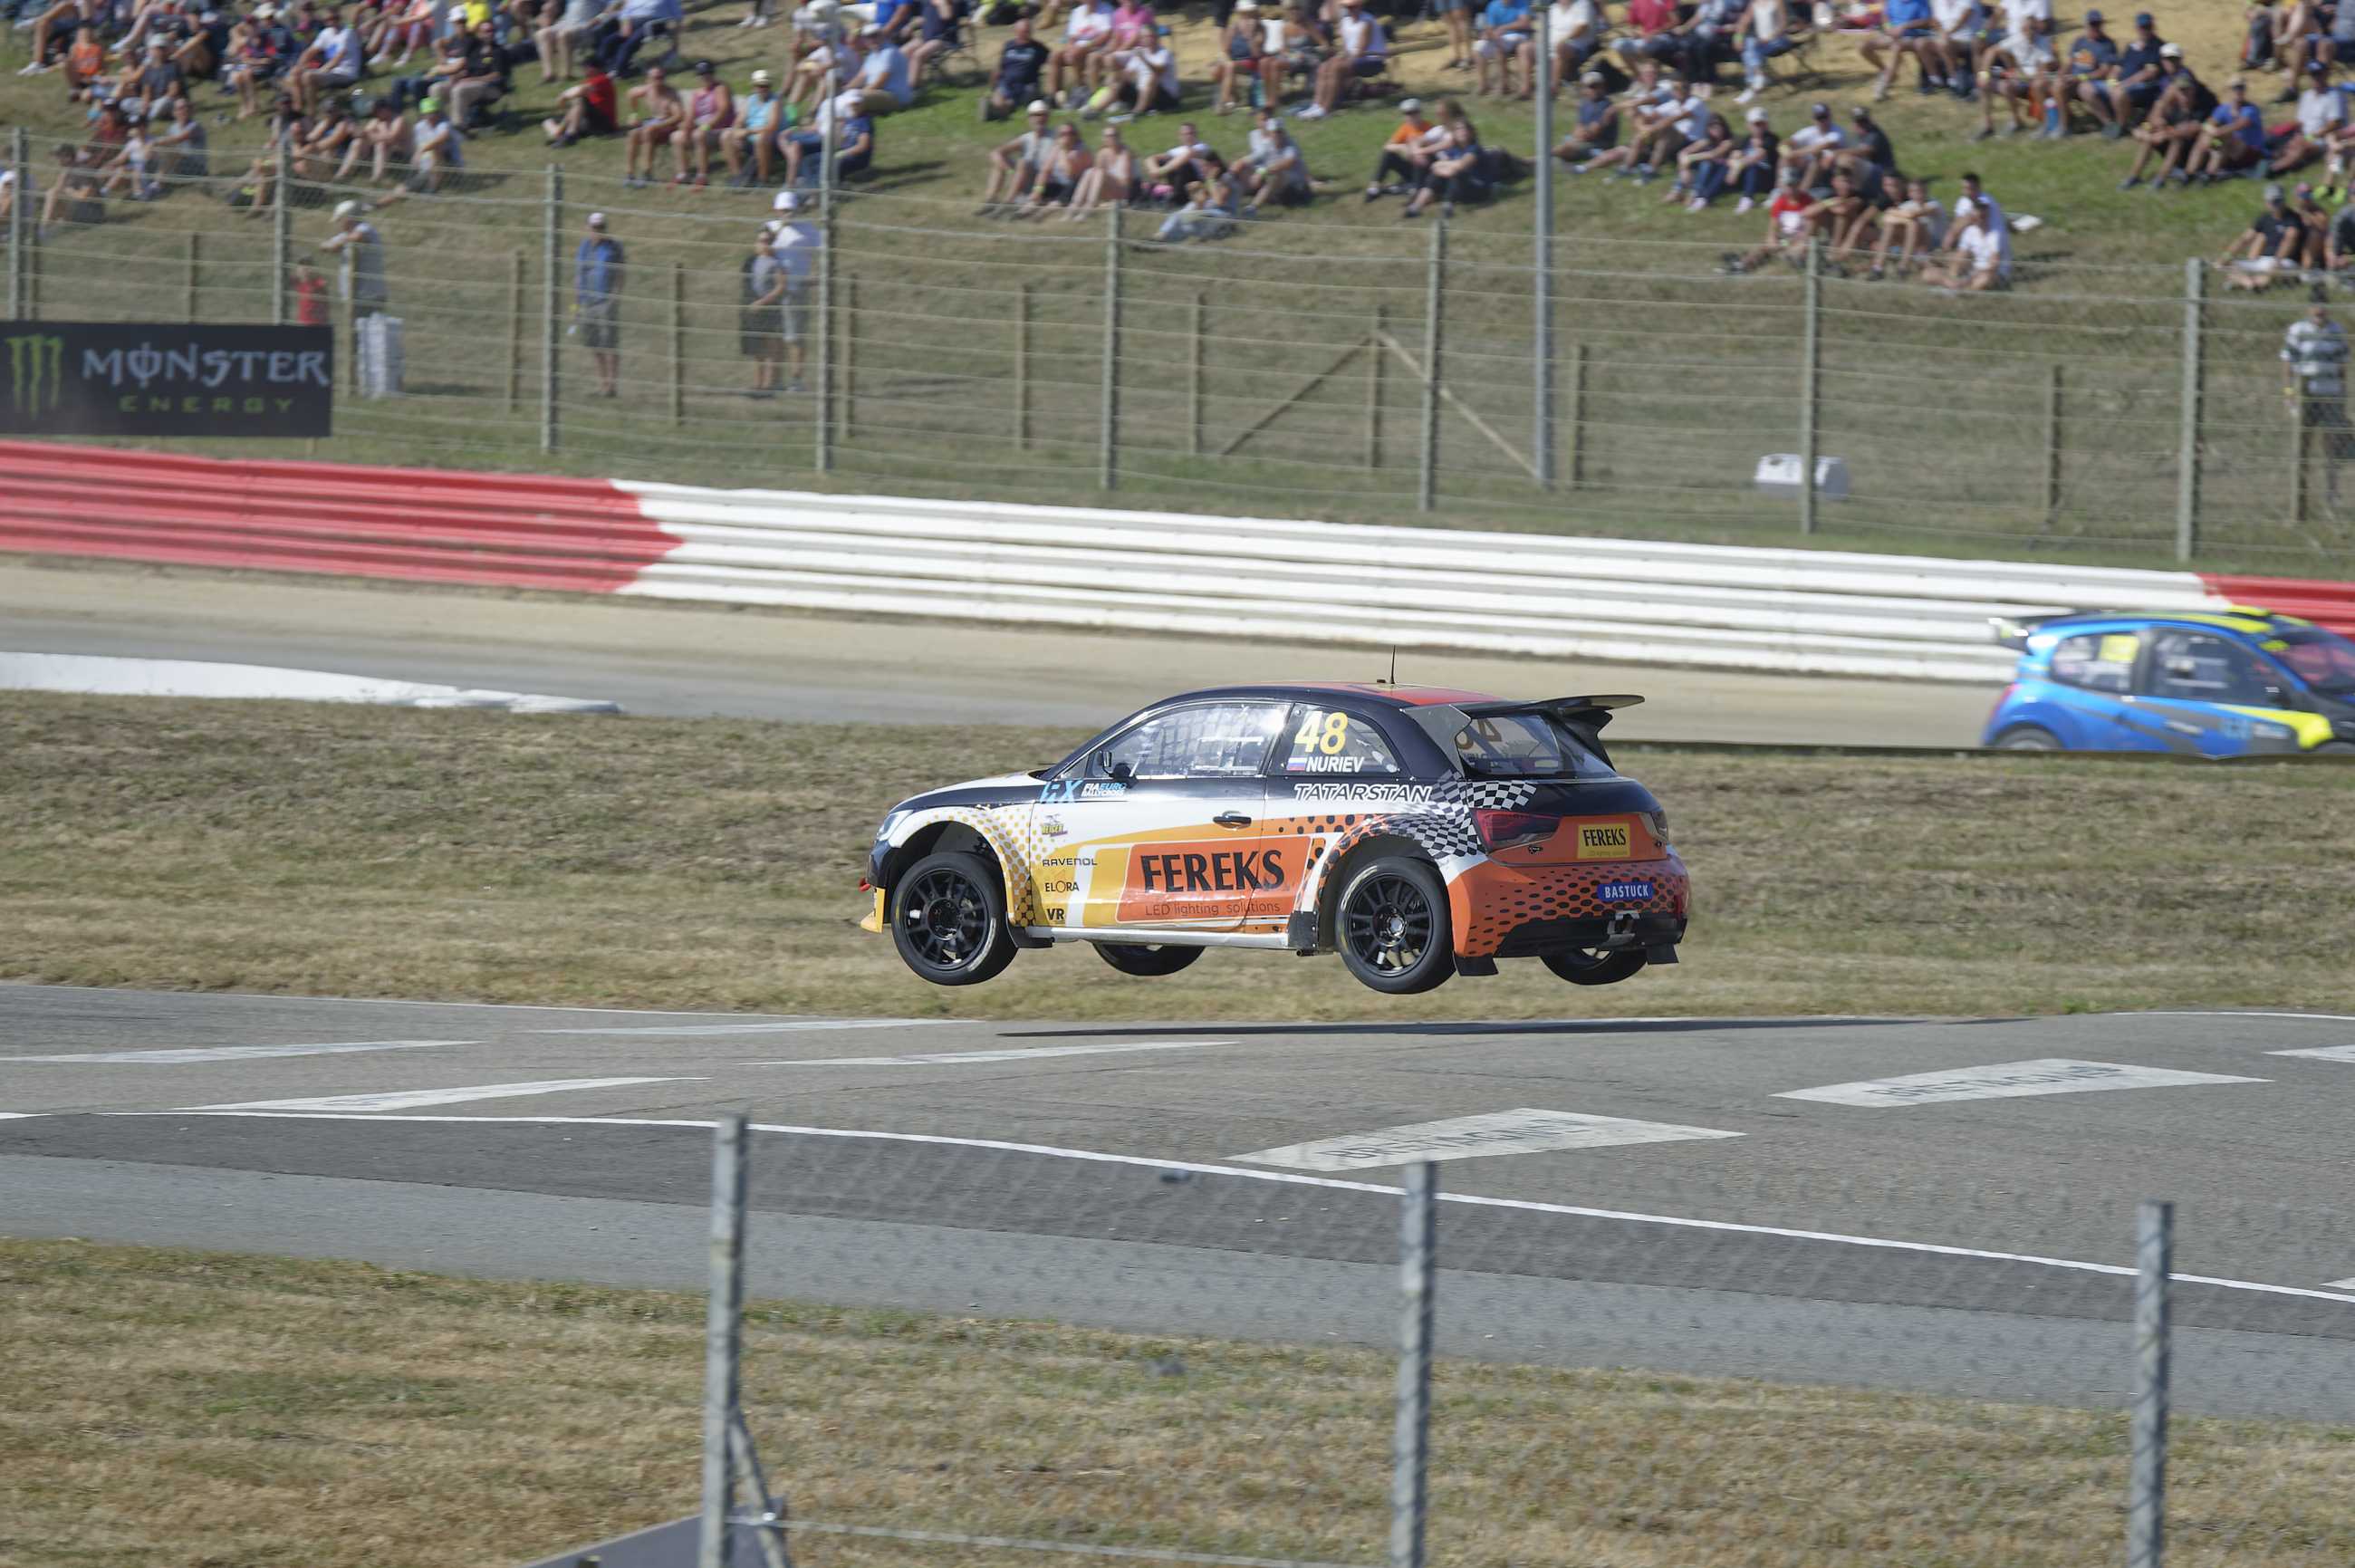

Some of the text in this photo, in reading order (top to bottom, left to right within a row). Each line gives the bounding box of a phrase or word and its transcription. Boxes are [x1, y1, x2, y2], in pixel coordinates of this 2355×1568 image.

[82, 342, 331, 389] MONSTER
[1294, 710, 1349, 755] 48
[1305, 755, 1364, 773] NURIEV
[1294, 783, 1432, 803] TATARSTAN
[1582, 828, 1627, 847] FEREKS
[1043, 858, 1098, 867] RAVENOL
[1140, 849, 1285, 893] FEREKS
[1044, 880, 1080, 893] ELORA
[1604, 884, 1648, 899] BASTUCK
[1046, 908, 1065, 920] VR
[1145, 901, 1281, 916] LED lighting solutions
